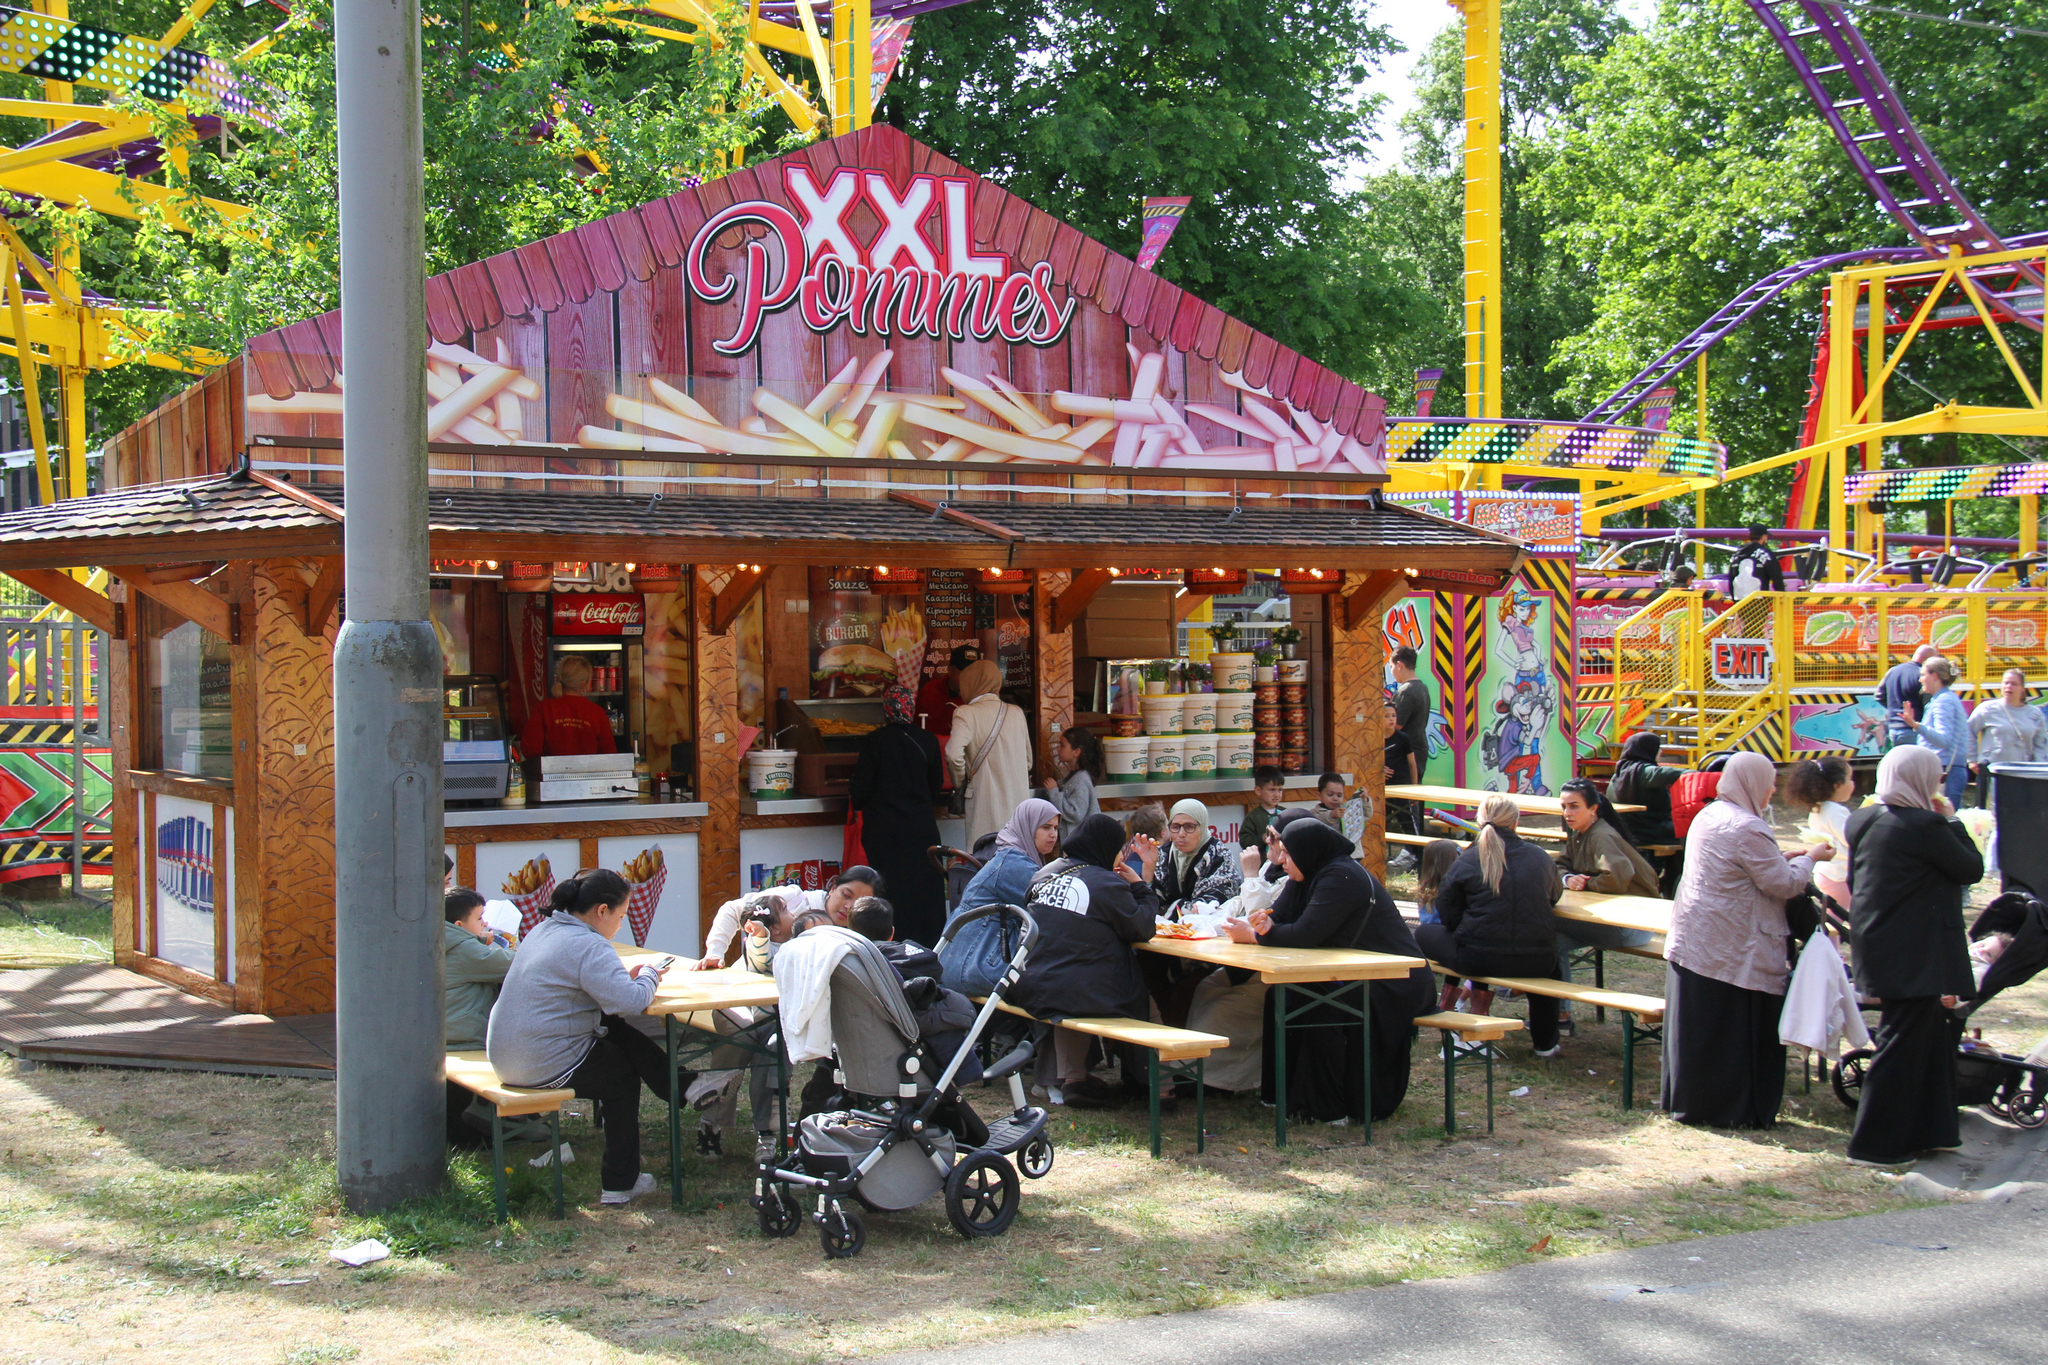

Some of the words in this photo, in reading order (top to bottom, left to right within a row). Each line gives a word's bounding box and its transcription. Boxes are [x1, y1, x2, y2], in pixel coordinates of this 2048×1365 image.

[782, 161, 1011, 283] XXL
[687, 200, 1077, 354] Pommes
[513, 561, 543, 579] Kipcorn
[640, 564, 669, 579] Kroket
[892, 567, 918, 581] Frites
[931, 568, 965, 582] Kipcorn
[1417, 568, 1494, 586] risdranken
[827, 578, 869, 591] Sauze
[928, 582, 969, 591] Mexicano
[924, 592, 972, 605] Kaassouflé
[581, 602, 640, 625] Coca-Cola
[925, 605, 973, 619] Kipnuggets
[825, 624, 869, 641] BURGER
[930, 619, 967, 631] Bamihap
[930, 639, 949, 649] Alle
[530, 611, 545, 701] Coca-Cola
[1715, 643, 1769, 679] EXIT
[194, 661, 230, 676] Hambu
[1004, 675, 1031, 687] Broodj
[1051, 872, 1073, 887] THE
[1034, 893, 1065, 908] FACE
